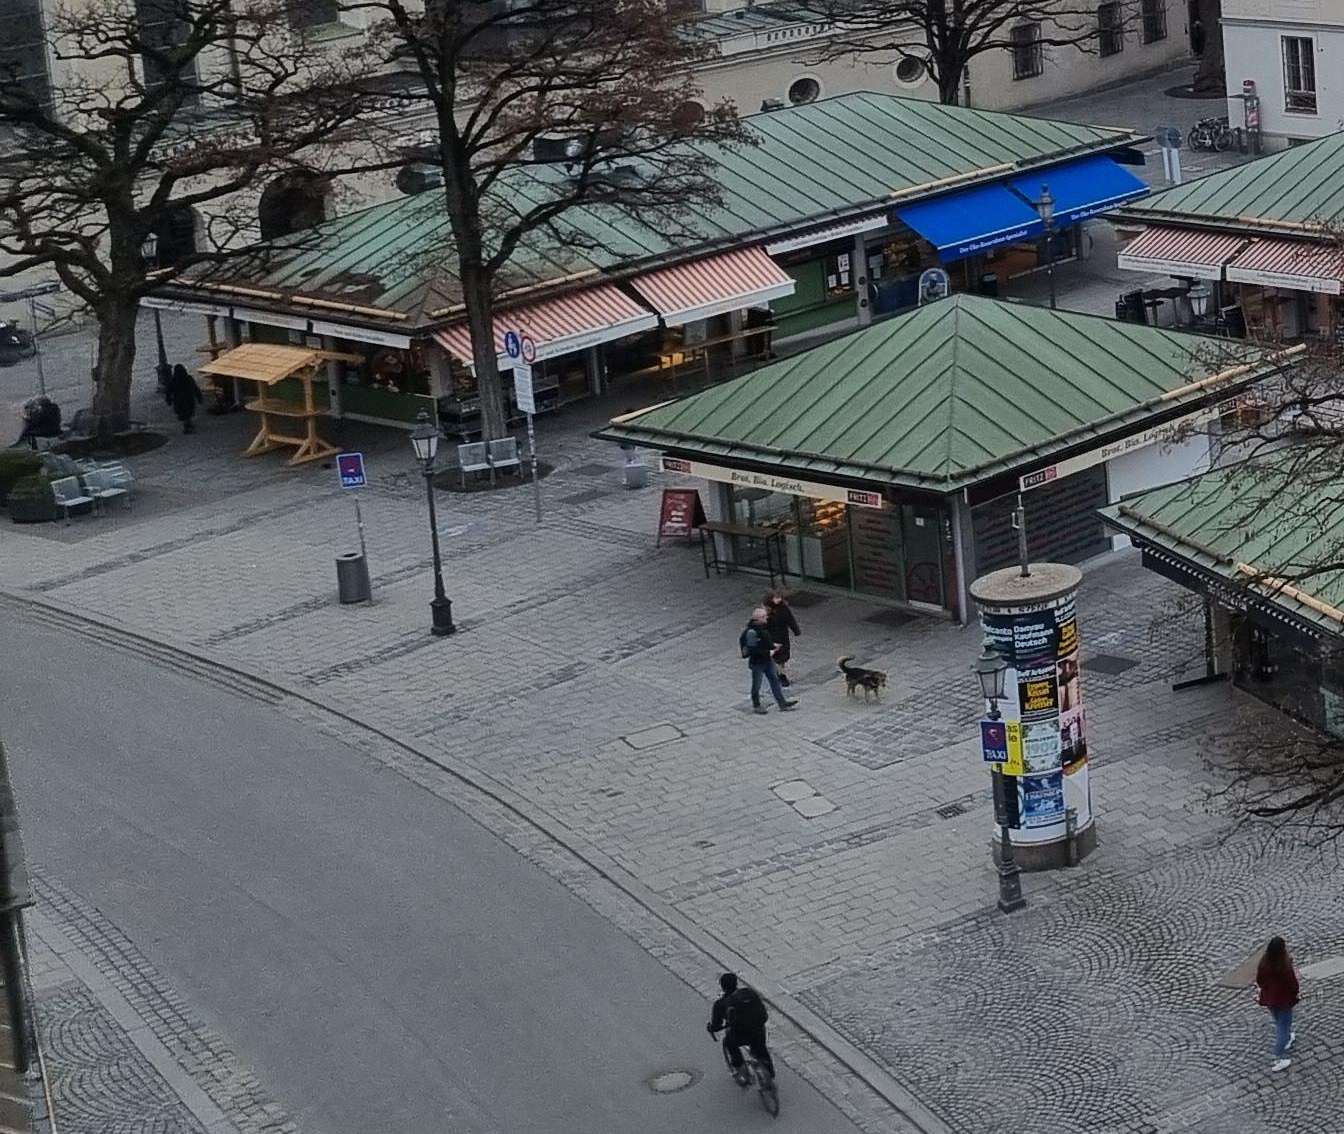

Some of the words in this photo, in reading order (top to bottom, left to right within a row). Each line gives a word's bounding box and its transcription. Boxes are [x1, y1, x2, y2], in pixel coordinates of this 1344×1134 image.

[1025, 471, 1044, 488] FRITZ
[1015, 637, 1048, 648] Deutsch
[984, 749, 1006, 759] TAXI
